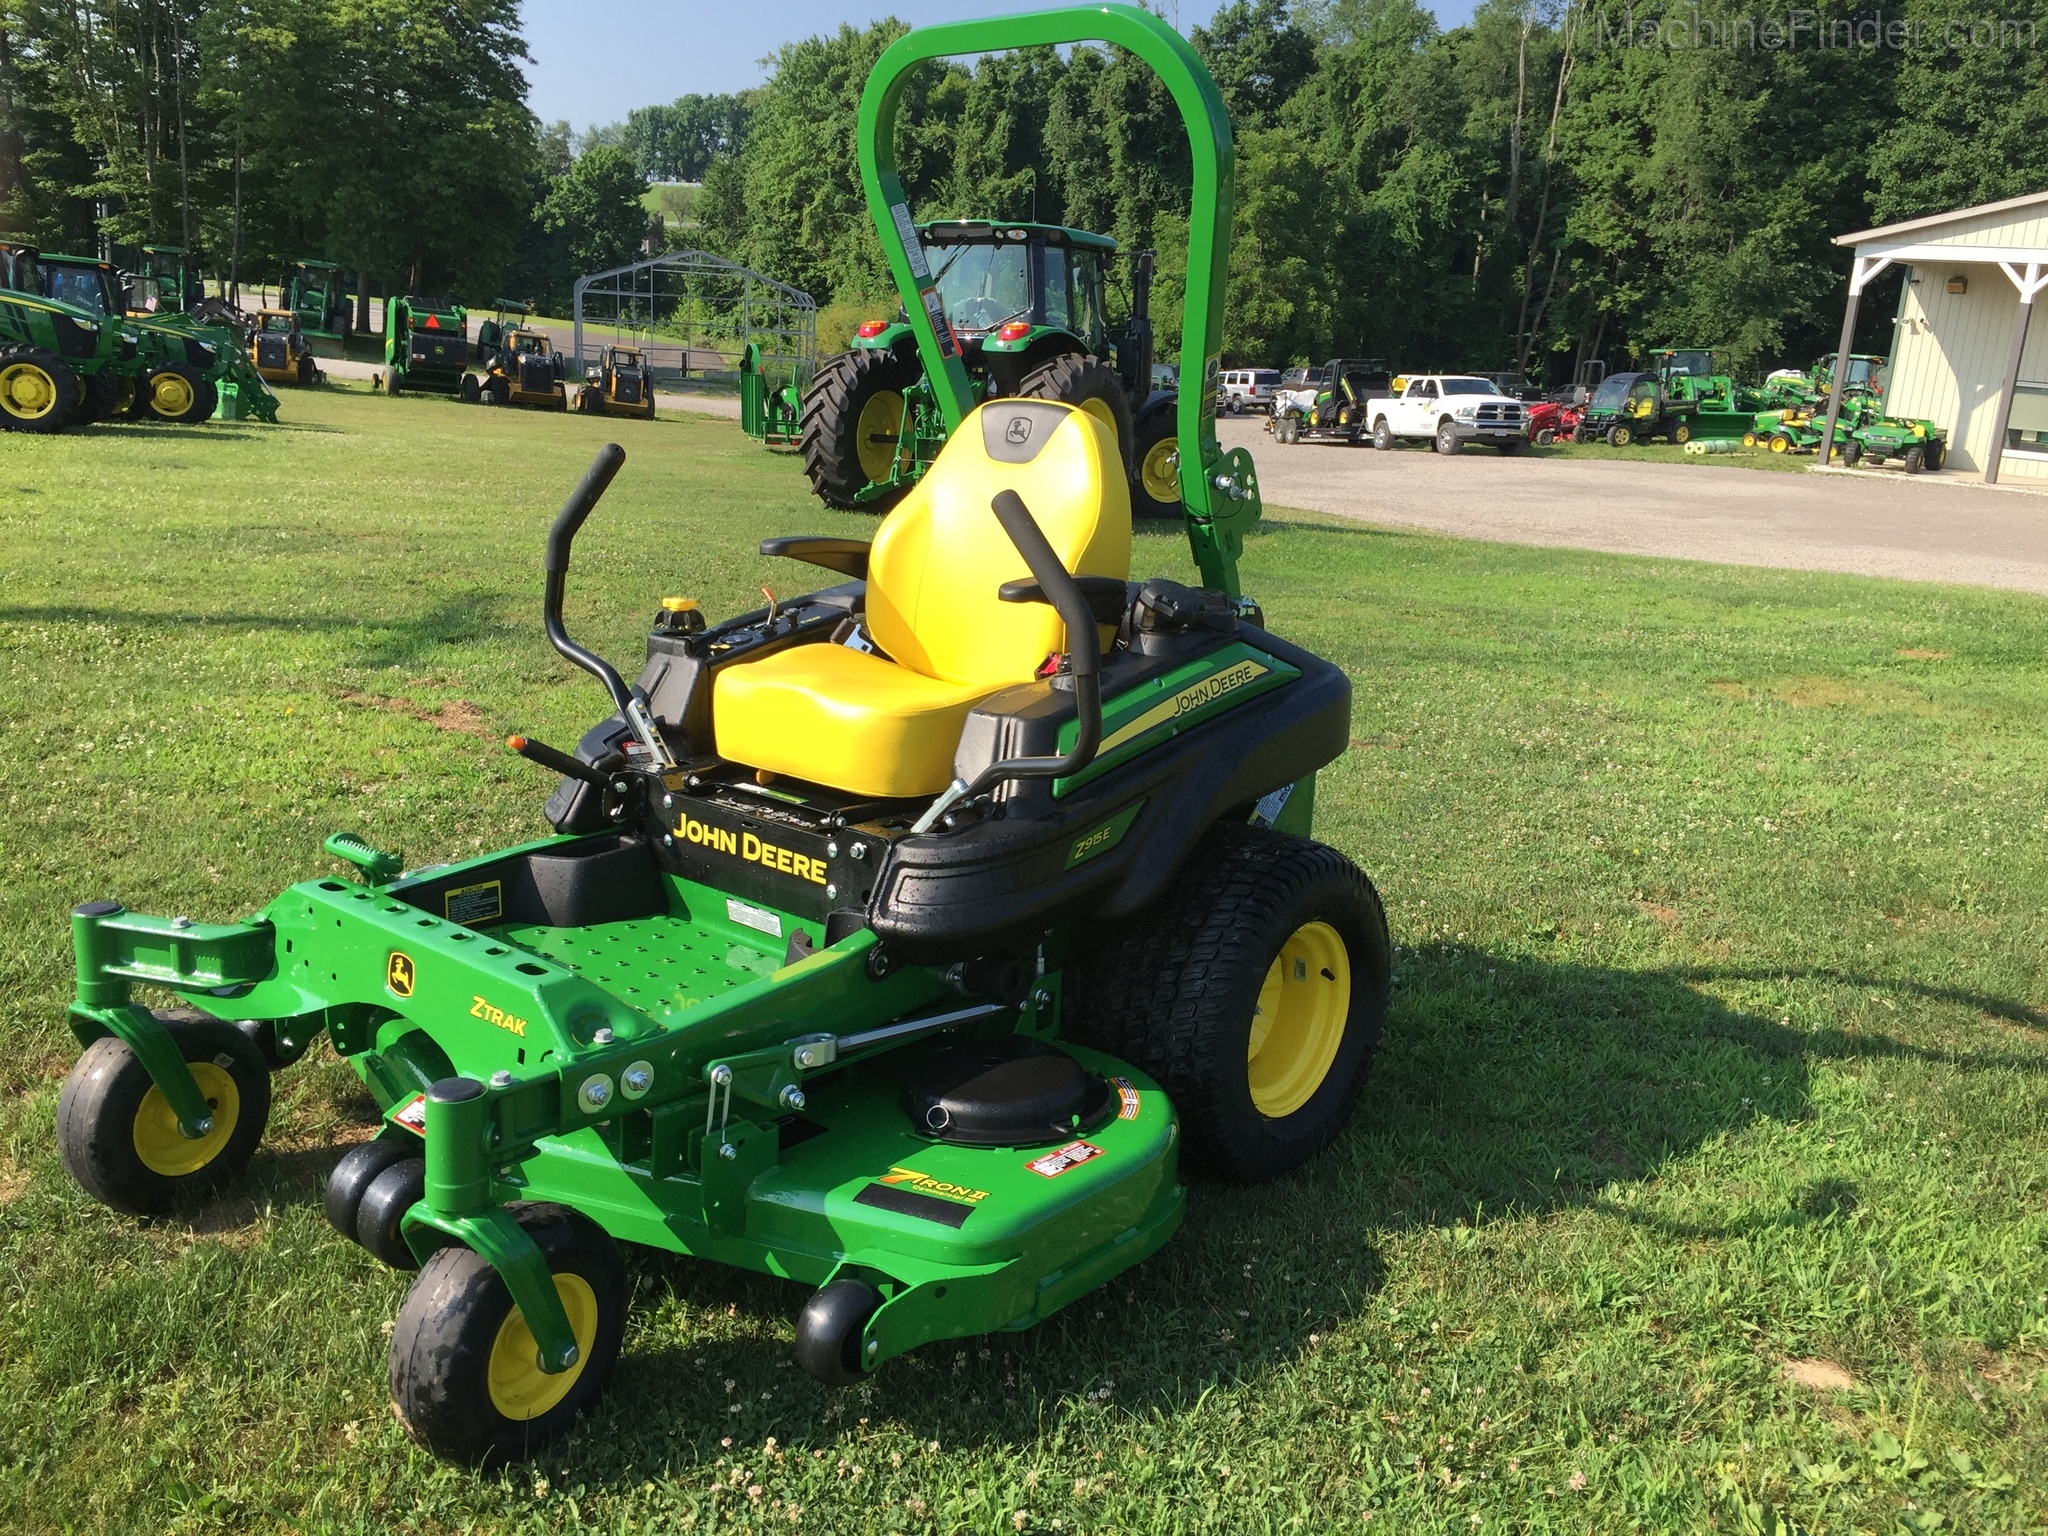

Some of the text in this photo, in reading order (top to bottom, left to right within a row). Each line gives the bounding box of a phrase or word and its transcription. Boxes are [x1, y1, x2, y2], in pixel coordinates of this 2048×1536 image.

[1174, 665, 1254, 716] JOHN DEERE
[673, 812, 737, 855] JOHN
[742, 831, 828, 885] DEERE
[1074, 826, 1112, 860] Z915E
[469, 995, 529, 1038] ZTRAK
